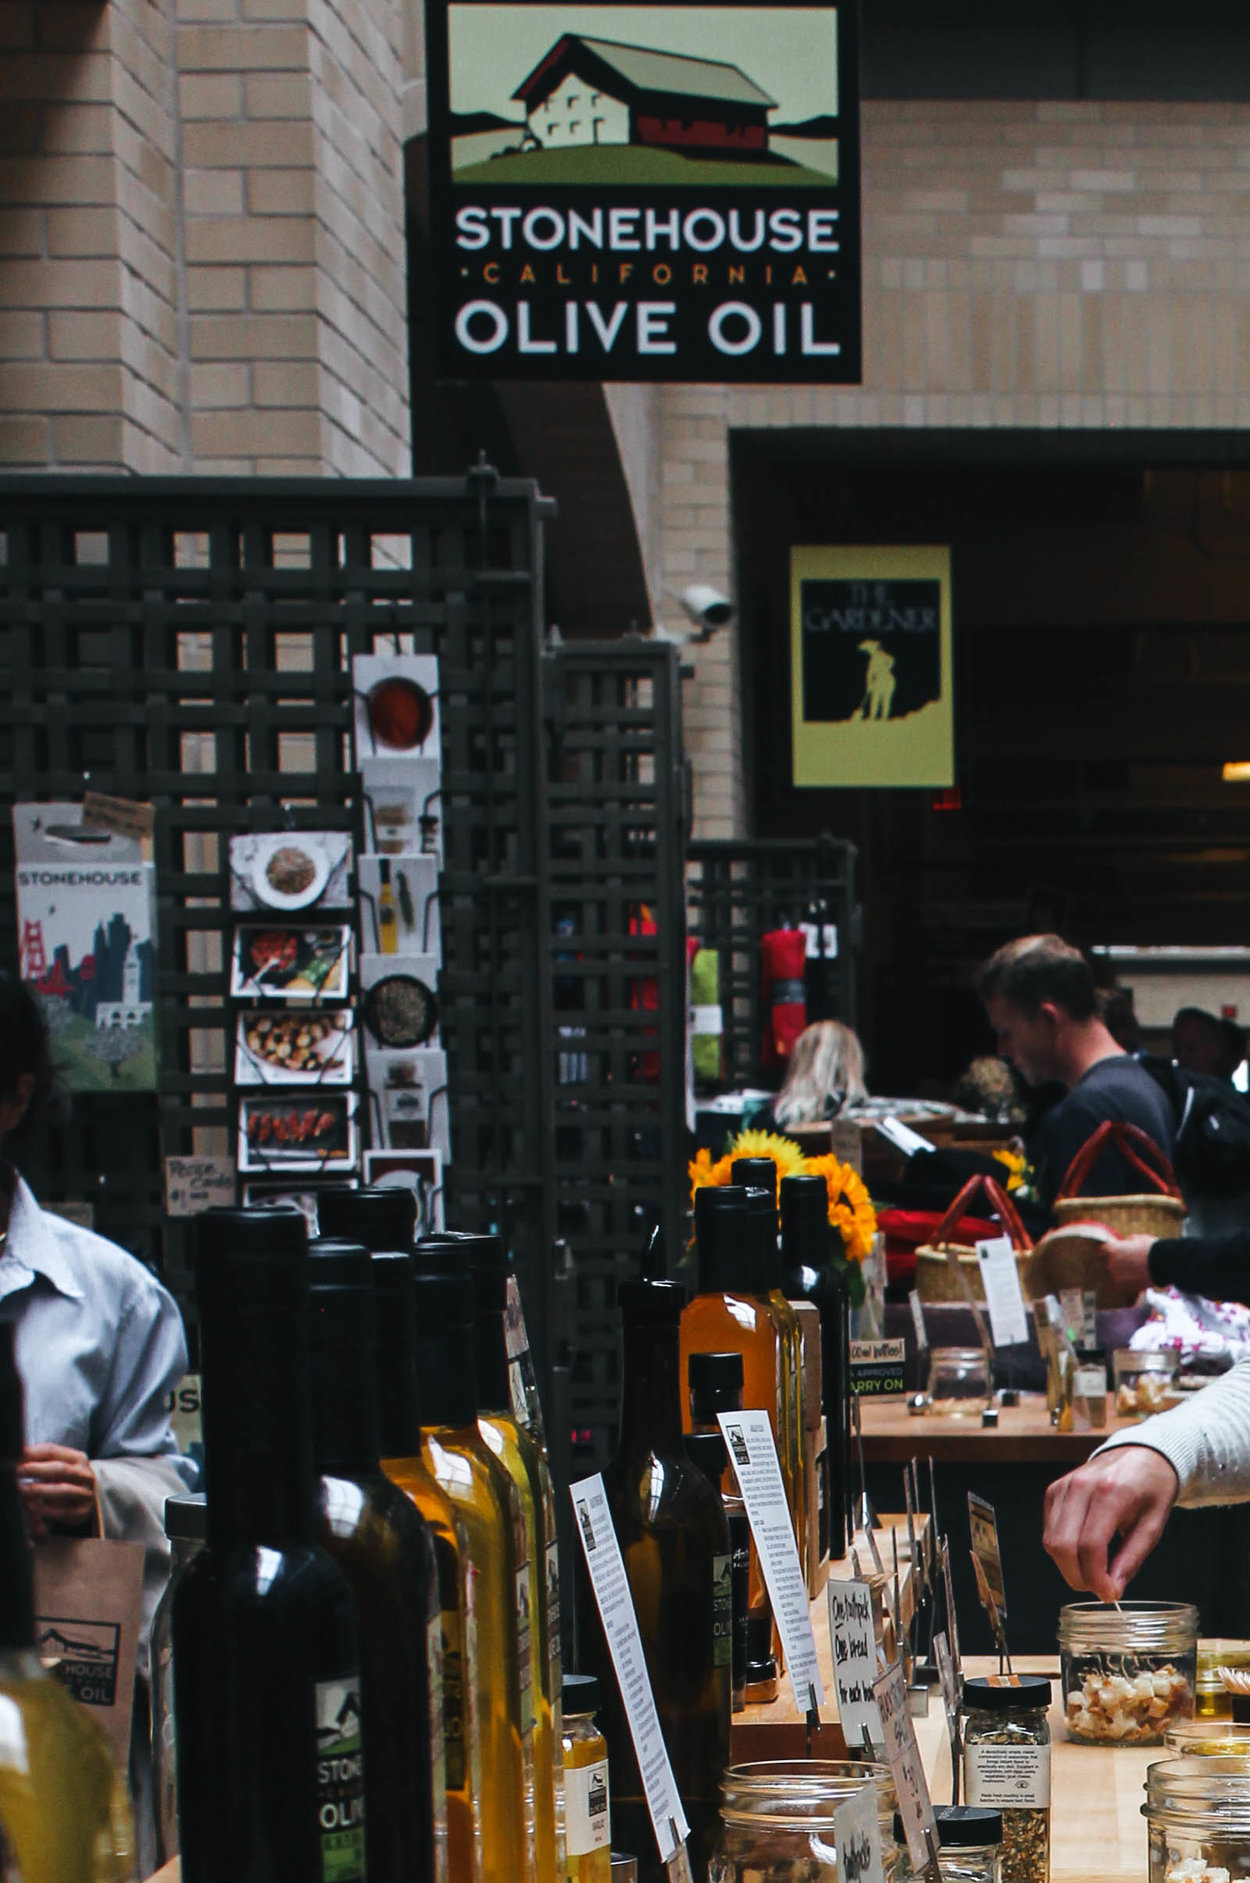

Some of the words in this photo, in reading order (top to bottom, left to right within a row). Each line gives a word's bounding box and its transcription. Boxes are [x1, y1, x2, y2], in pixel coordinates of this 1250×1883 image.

[455, 206, 840, 252] STONEHOUSE
[483, 262, 808, 285] CALIFORNIA
[455, 299, 677, 355] OLIVE
[708, 301, 841, 356] OIL
[806, 607, 936, 632] GARDENER
[19, 871, 142, 887] STONEHOUSE
[884, 1379, 903, 1390] ON
[81, 1686, 111, 1702] OIL
